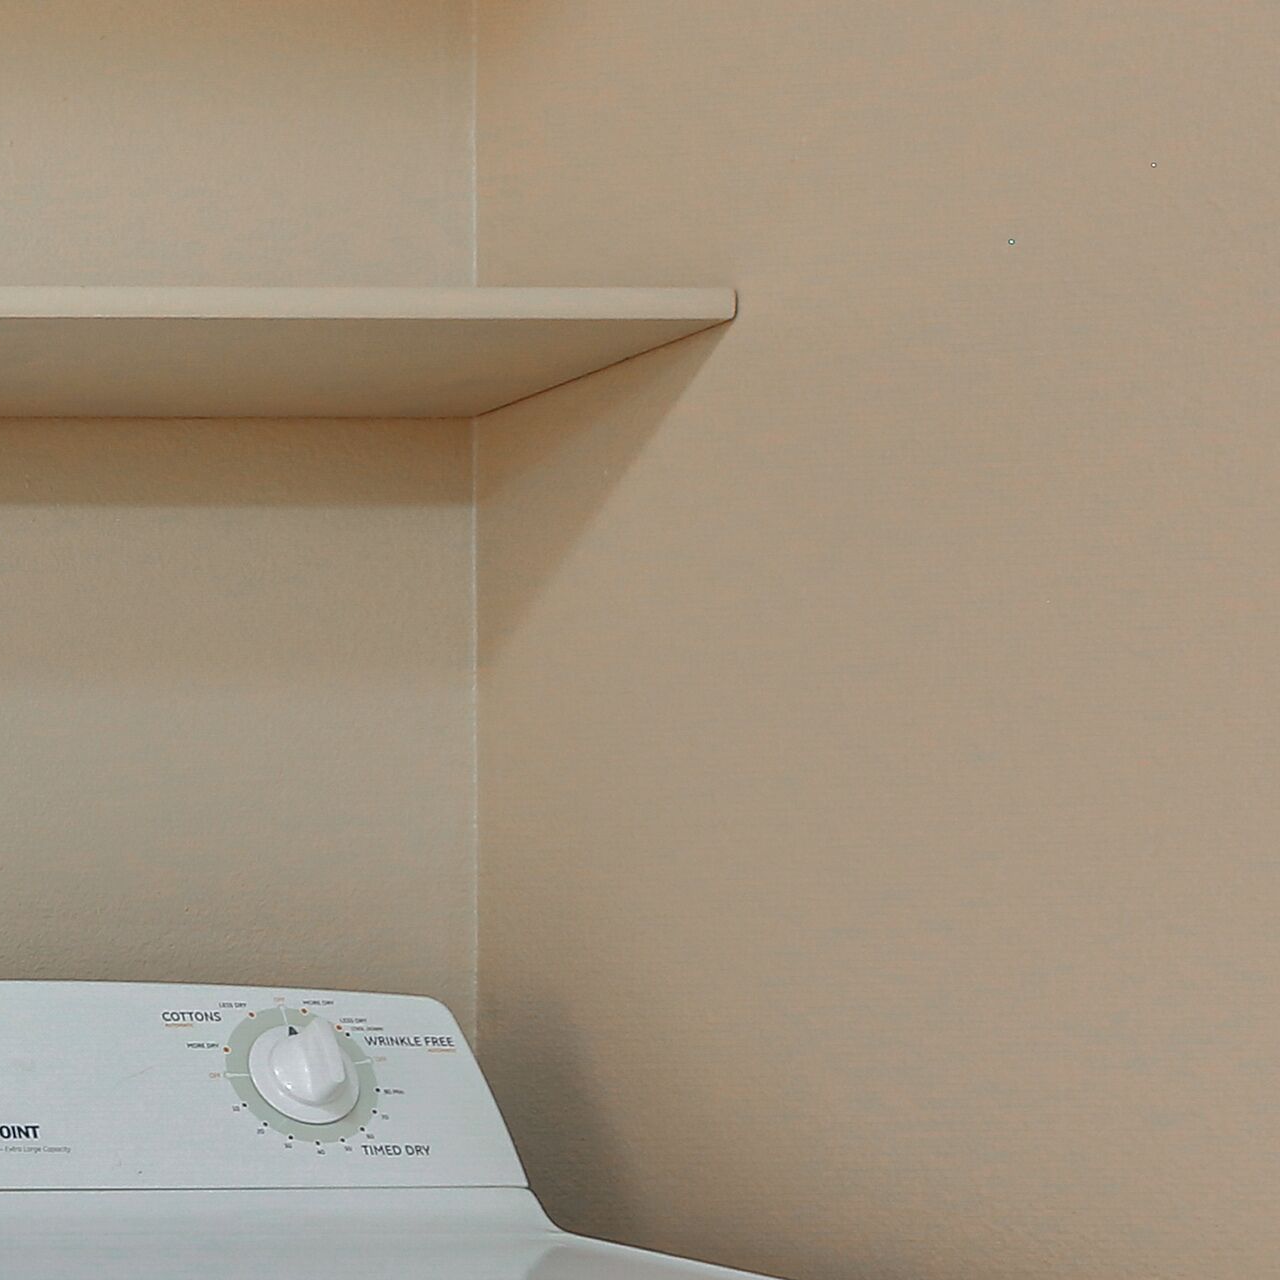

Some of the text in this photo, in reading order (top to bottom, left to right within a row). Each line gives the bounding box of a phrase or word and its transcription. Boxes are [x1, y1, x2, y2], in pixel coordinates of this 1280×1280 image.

[161, 1011, 222, 1022] COTTONS
[364, 1036, 455, 1047] WRINKLE FREE
[361, 1144, 432, 1156] TIMED DRY
